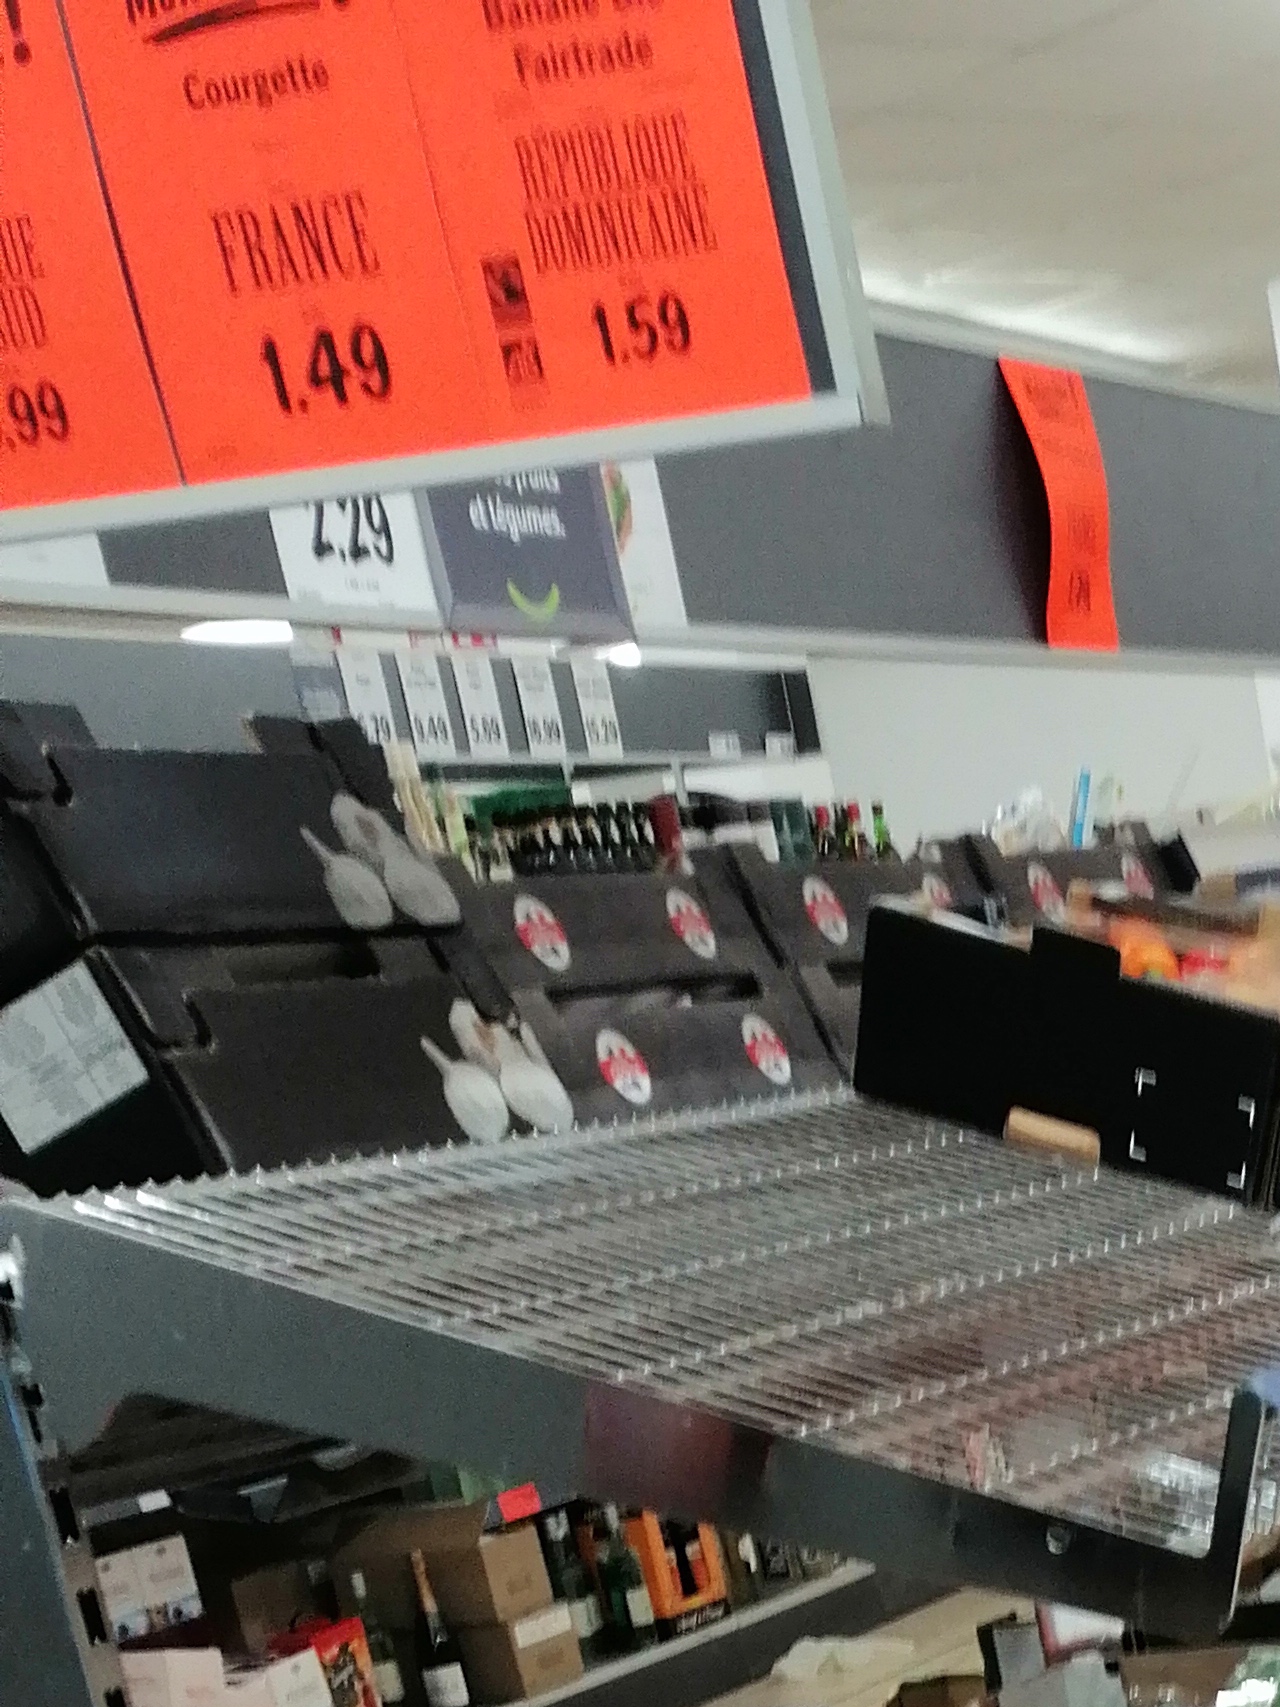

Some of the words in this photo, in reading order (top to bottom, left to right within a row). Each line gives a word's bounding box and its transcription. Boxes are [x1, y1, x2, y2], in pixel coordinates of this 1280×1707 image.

[183, 54, 330, 110] Courgette
[513, 30, 655, 91] Fairtrade
[207, 190, 382, 297] FRANCE
[524, 184, 718, 275] DOMINICAINE
[261, 321, 393, 415] 1.49
[592, 289, 692, 367] 1.59
